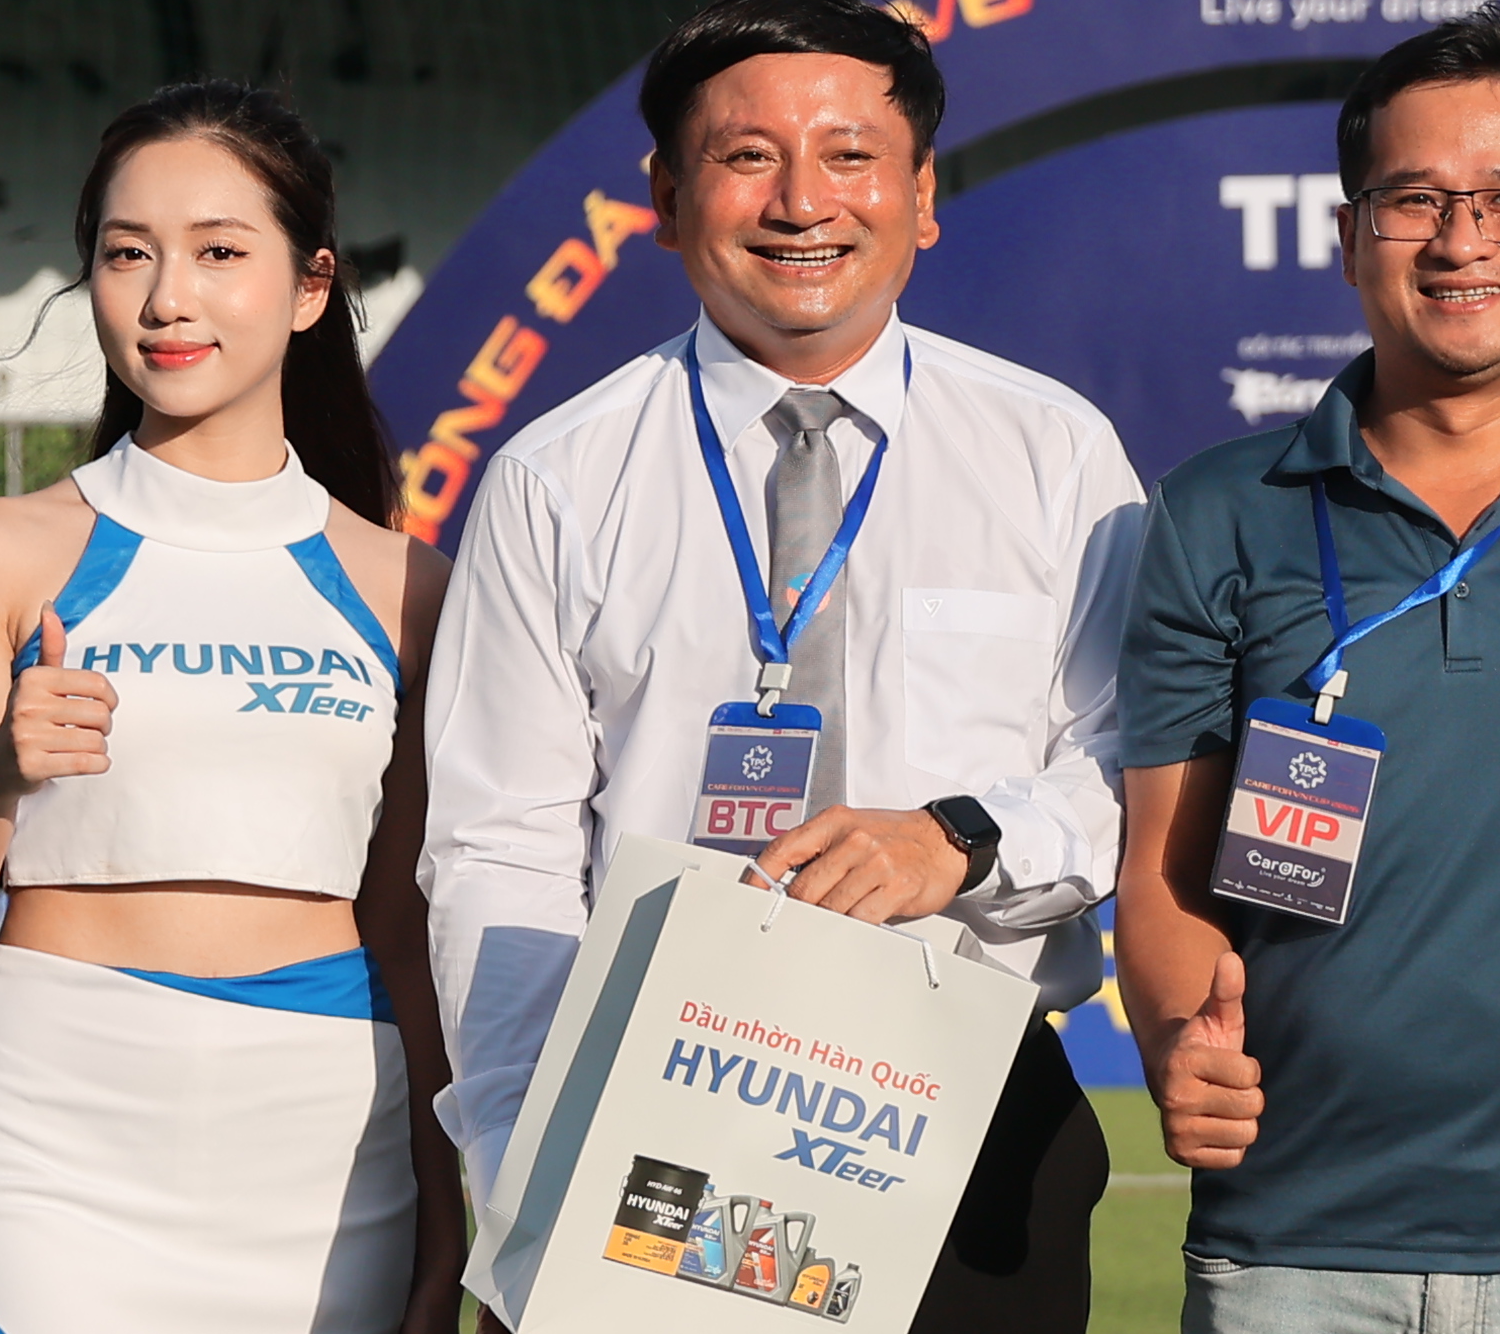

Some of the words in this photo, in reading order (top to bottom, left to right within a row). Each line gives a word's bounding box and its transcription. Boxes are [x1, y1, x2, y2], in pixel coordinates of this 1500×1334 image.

[80, 642, 373, 688] HYUNDAI
[236, 681, 375, 724] XTeer
[1298, 762, 1318, 776] TPG
[706, 799, 793, 837] BTC
[1254, 797, 1341, 848] VIP
[678, 1000, 729, 1033] Dầu
[732, 1019, 803, 1055] nhờn
[808, 1039, 864, 1075] Hàn
[870, 1061, 942, 1101] Quốc
[662, 1038, 929, 1157] HYUNDAI
[772, 1126, 907, 1193] XTeer
[646, 1179, 661, 1190] HYD
[626, 1193, 691, 1221] HYUNDAI
[652, 1214, 685, 1231] XTeer
